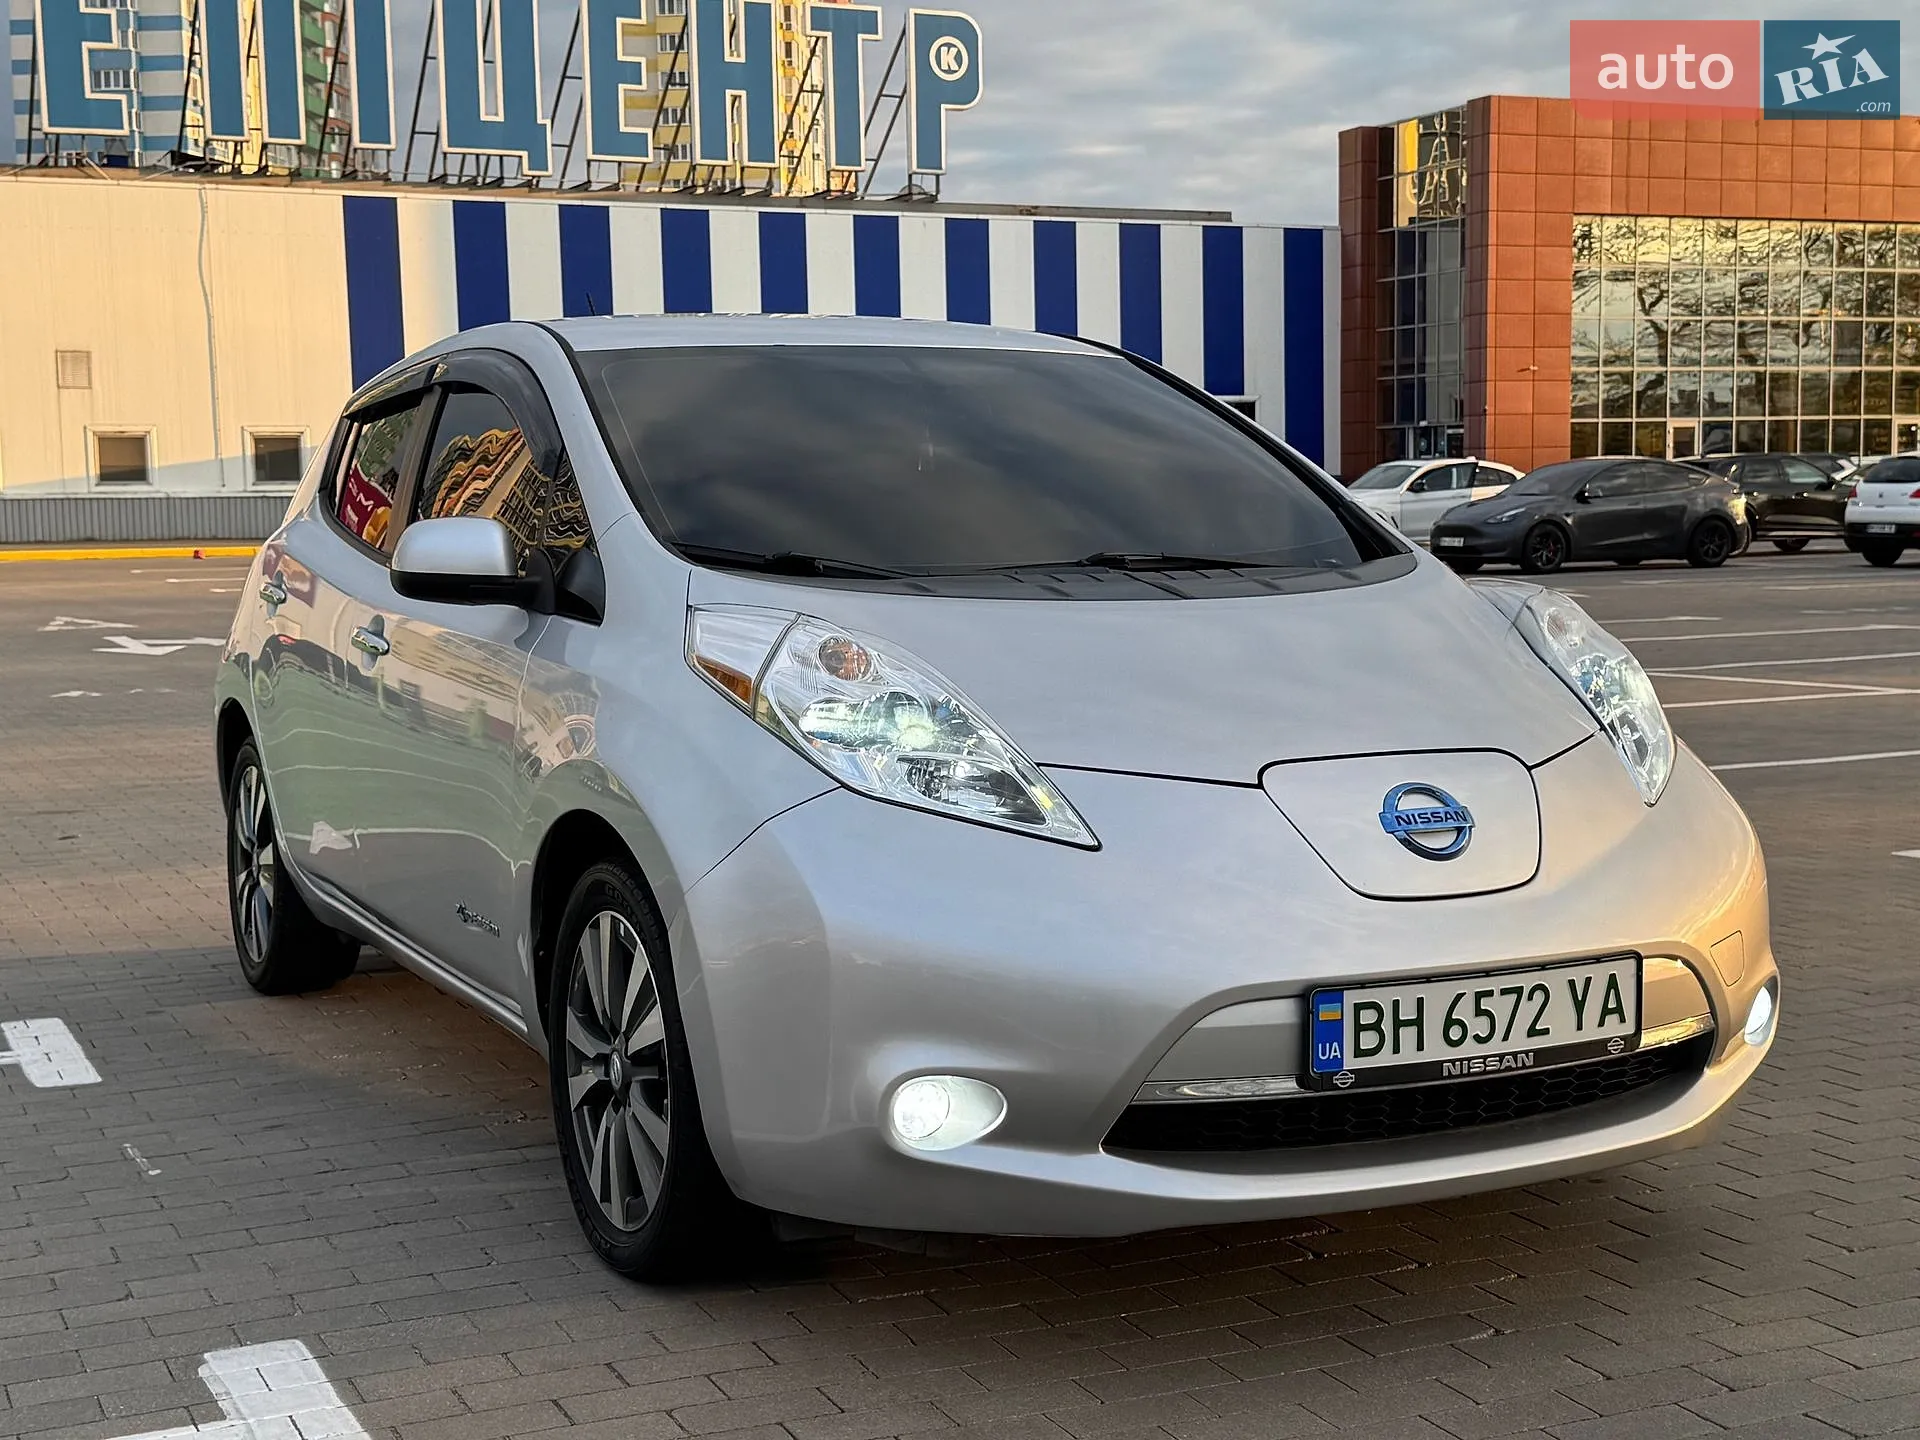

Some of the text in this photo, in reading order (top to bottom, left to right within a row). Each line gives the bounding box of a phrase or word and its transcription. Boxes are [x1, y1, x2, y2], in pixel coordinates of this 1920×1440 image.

[1394, 810, 1468, 827] NISSAN
[1353, 972, 1627, 1058] BH 6572 YA
[1318, 1041, 1342, 1060] UA
[1442, 1052, 1535, 1077] NISSAN
